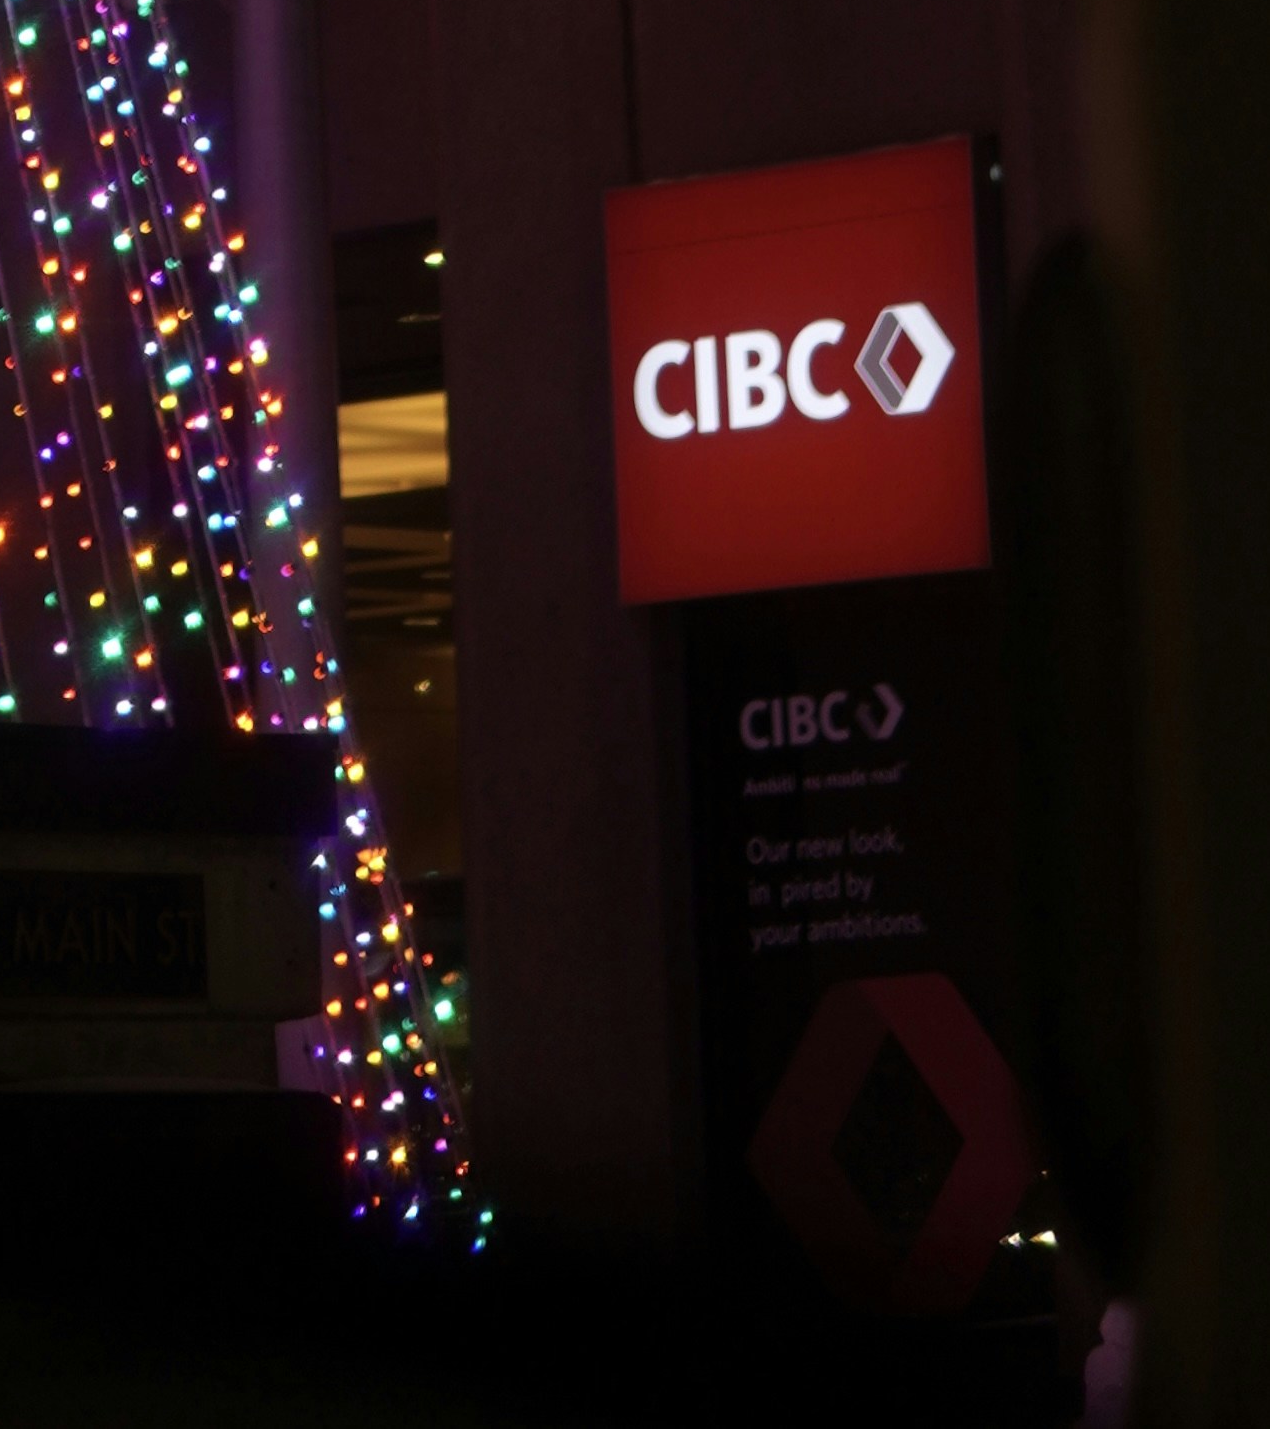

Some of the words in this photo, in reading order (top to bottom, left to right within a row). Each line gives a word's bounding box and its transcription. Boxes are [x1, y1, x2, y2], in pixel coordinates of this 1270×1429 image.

[633, 318, 851, 440] CIBC
[739, 689, 851, 751] CIBC
[746, 835, 791, 864] Our
[796, 835, 845, 860] new
[844, 870, 875, 903] by
[13, 903, 137, 965] MAIN
[748, 922, 803, 954] your
[806, 910, 929, 943] ambitions.
